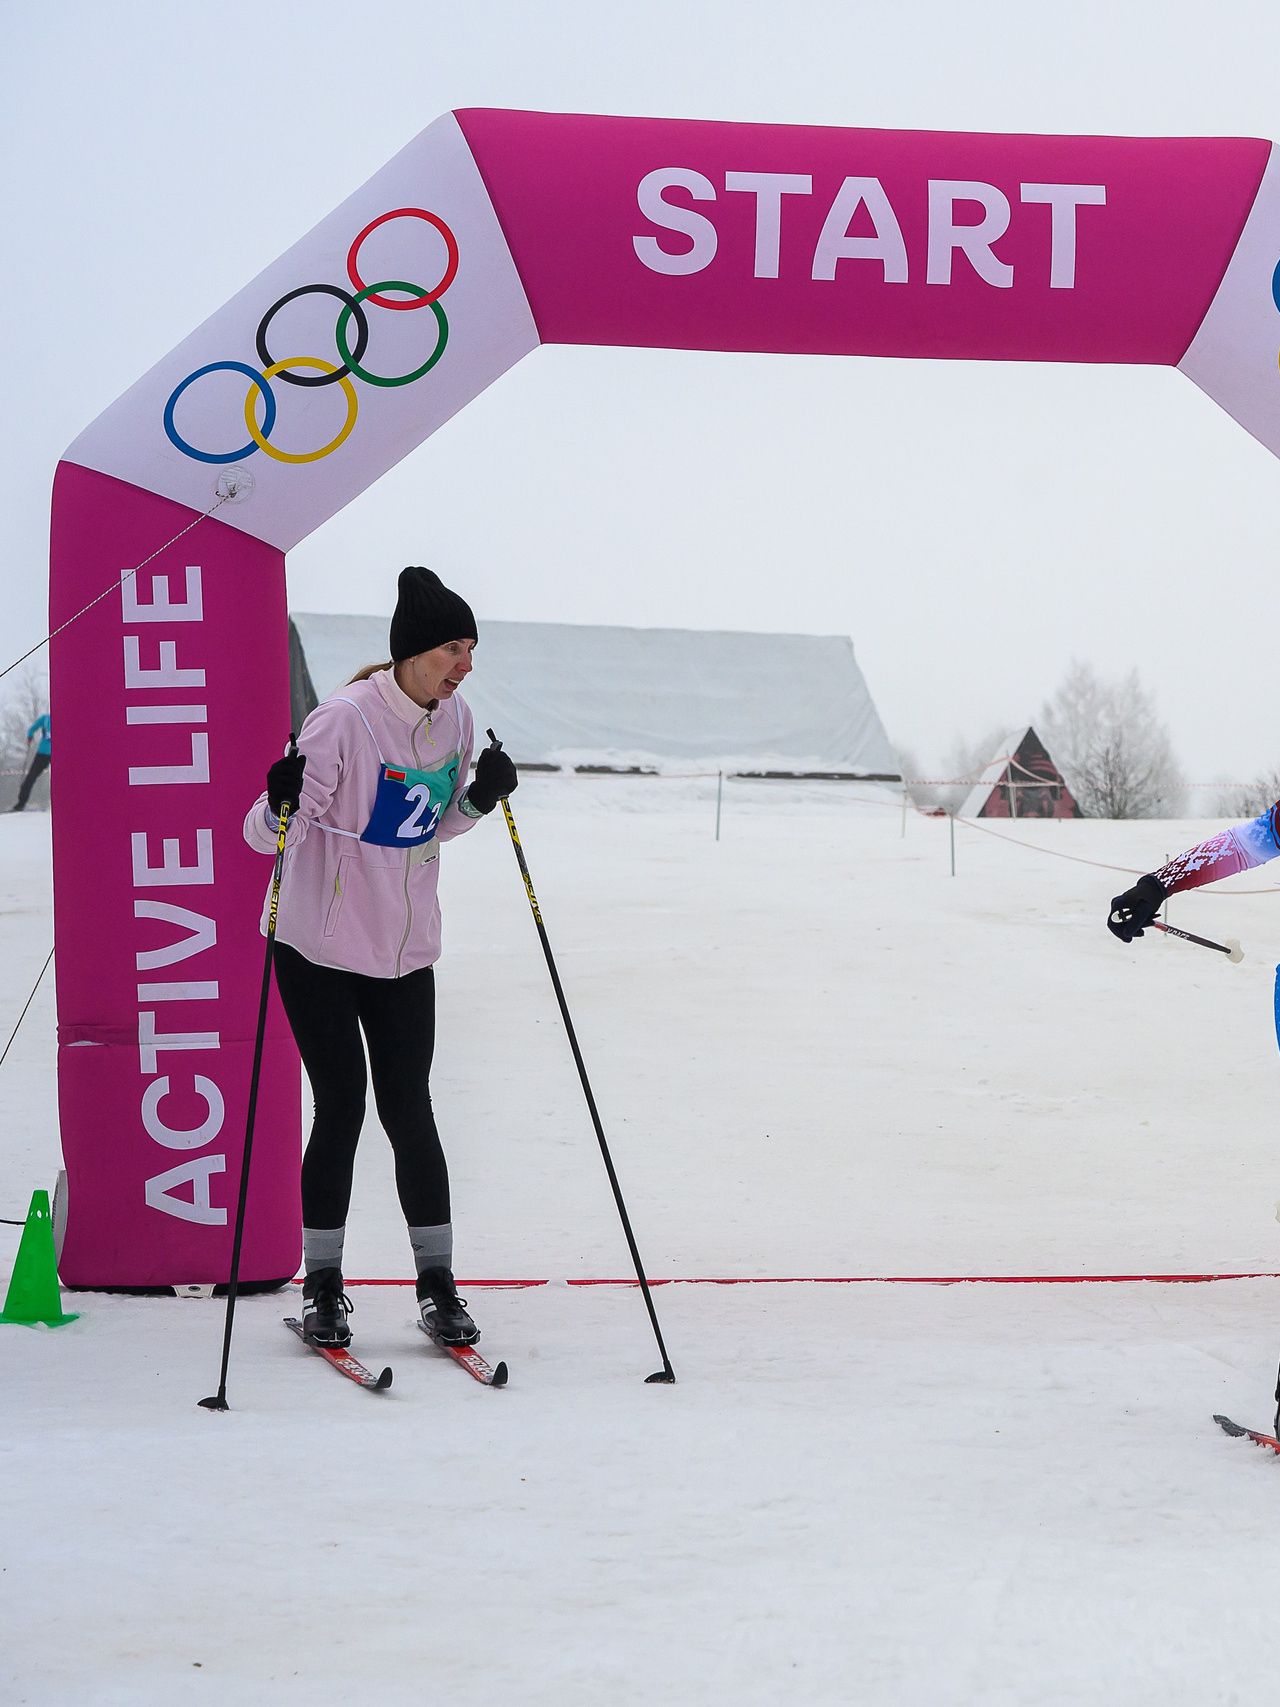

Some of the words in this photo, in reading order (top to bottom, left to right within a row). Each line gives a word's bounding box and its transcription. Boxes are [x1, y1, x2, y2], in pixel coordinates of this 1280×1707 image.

[632, 167, 1107, 289] START
[120, 566, 210, 786] LIFE
[131, 829, 228, 1226] ACTIVE
